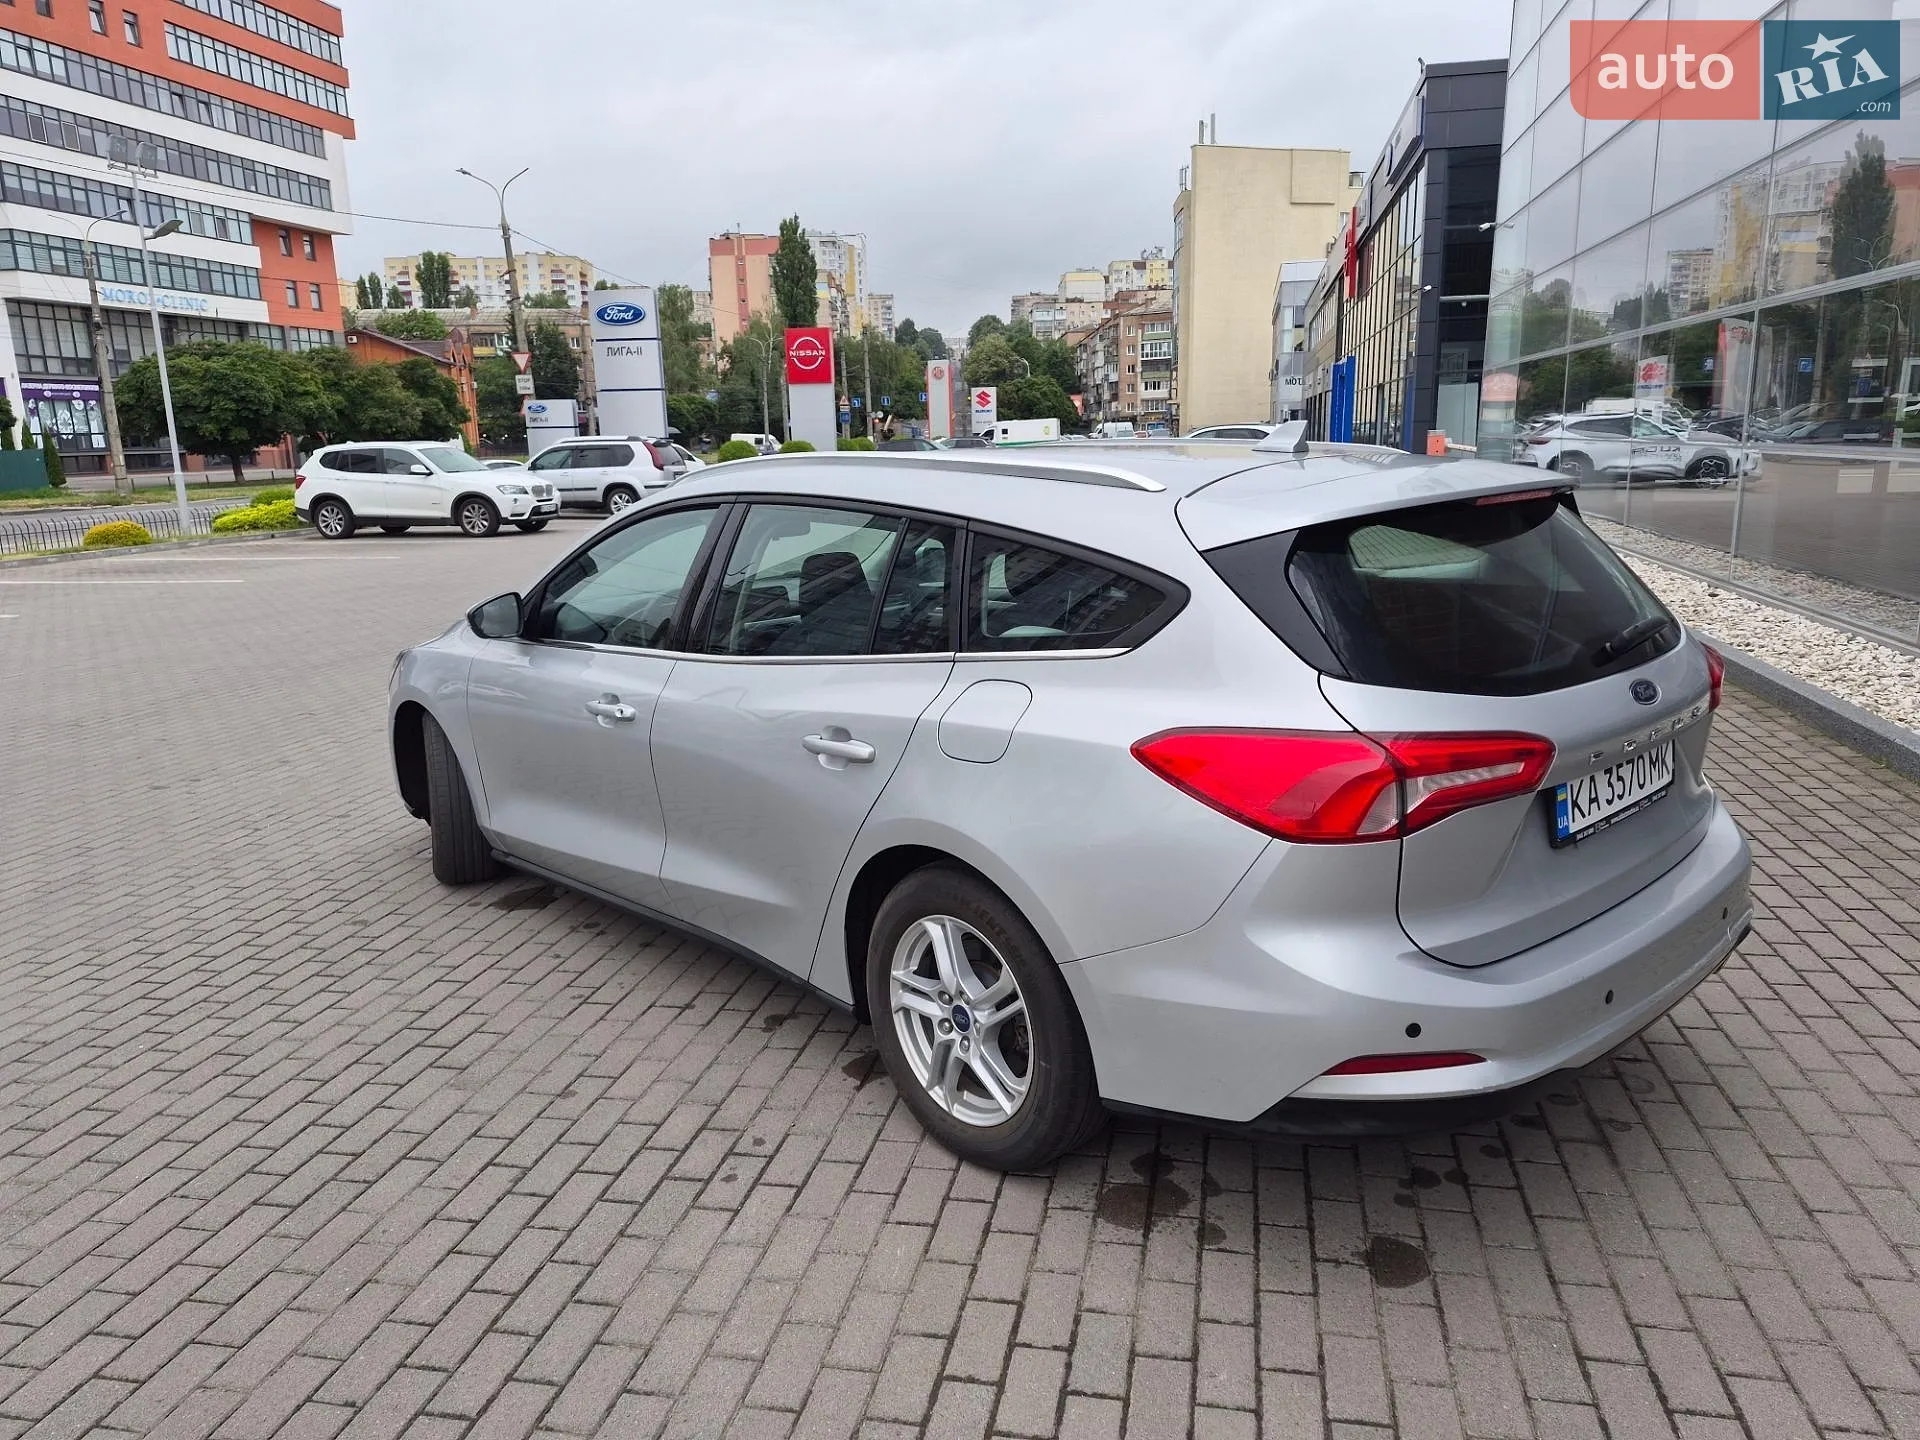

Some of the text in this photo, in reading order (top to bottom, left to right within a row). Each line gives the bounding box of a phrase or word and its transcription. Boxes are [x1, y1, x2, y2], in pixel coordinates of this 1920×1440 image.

[103, 287, 153, 305] MORO
[604, 306, 634, 320] Ford
[789, 349, 825, 357] NISSAN
[1558, 816, 1569, 829] UA
